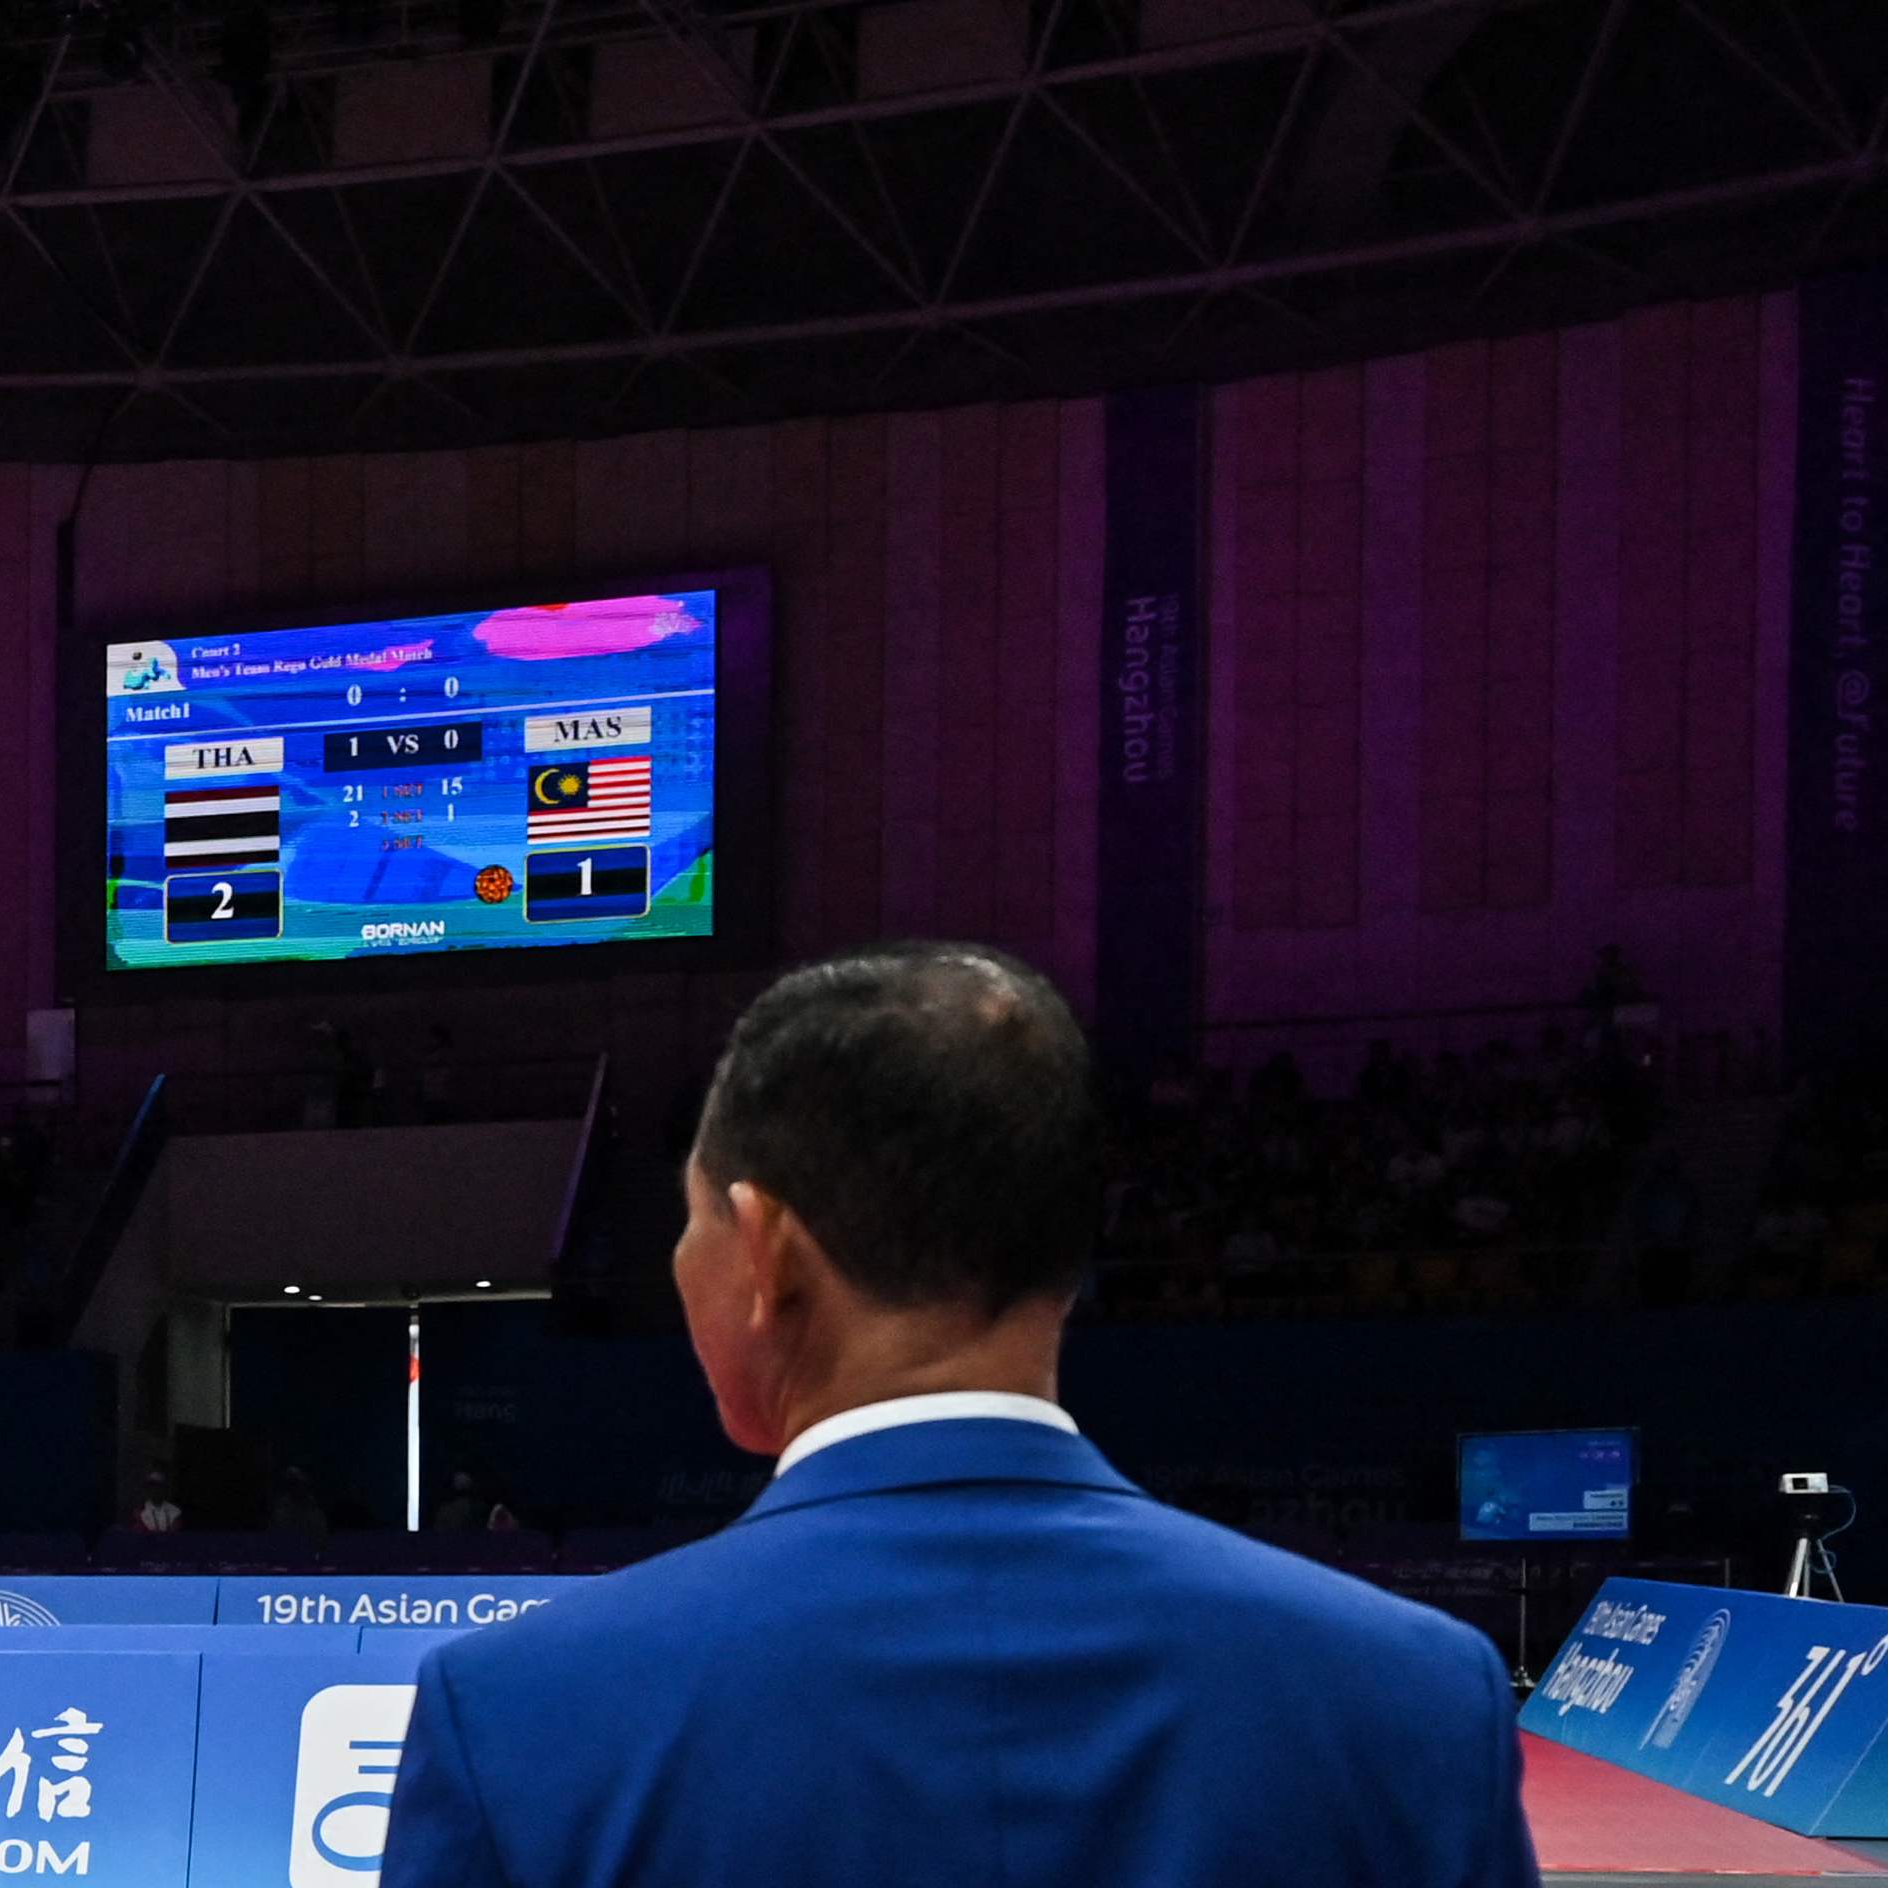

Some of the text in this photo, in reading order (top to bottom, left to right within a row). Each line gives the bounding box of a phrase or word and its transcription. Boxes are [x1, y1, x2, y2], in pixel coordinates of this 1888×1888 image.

[346, 683, 362, 707] 0
[444, 676, 460, 699] 0
[1119, 595, 1158, 784] Hangzhou
[348, 728, 459, 757] 1 VS 0
[554, 716, 622, 743] MAS
[193, 746, 255, 770] THA
[343, 784, 364, 803] 21
[441, 776, 463, 796] 15
[349, 810, 360, 828] 2
[447, 802, 456, 823] 1
[576, 857, 593, 897] 1
[210, 881, 235, 920] 2
[361, 919, 446, 941] BORNAN
[257, 1594, 341, 1624] 19th
[348, 1594, 458, 1624] Asian
[1542, 1641, 1634, 1717] Hangzhou
